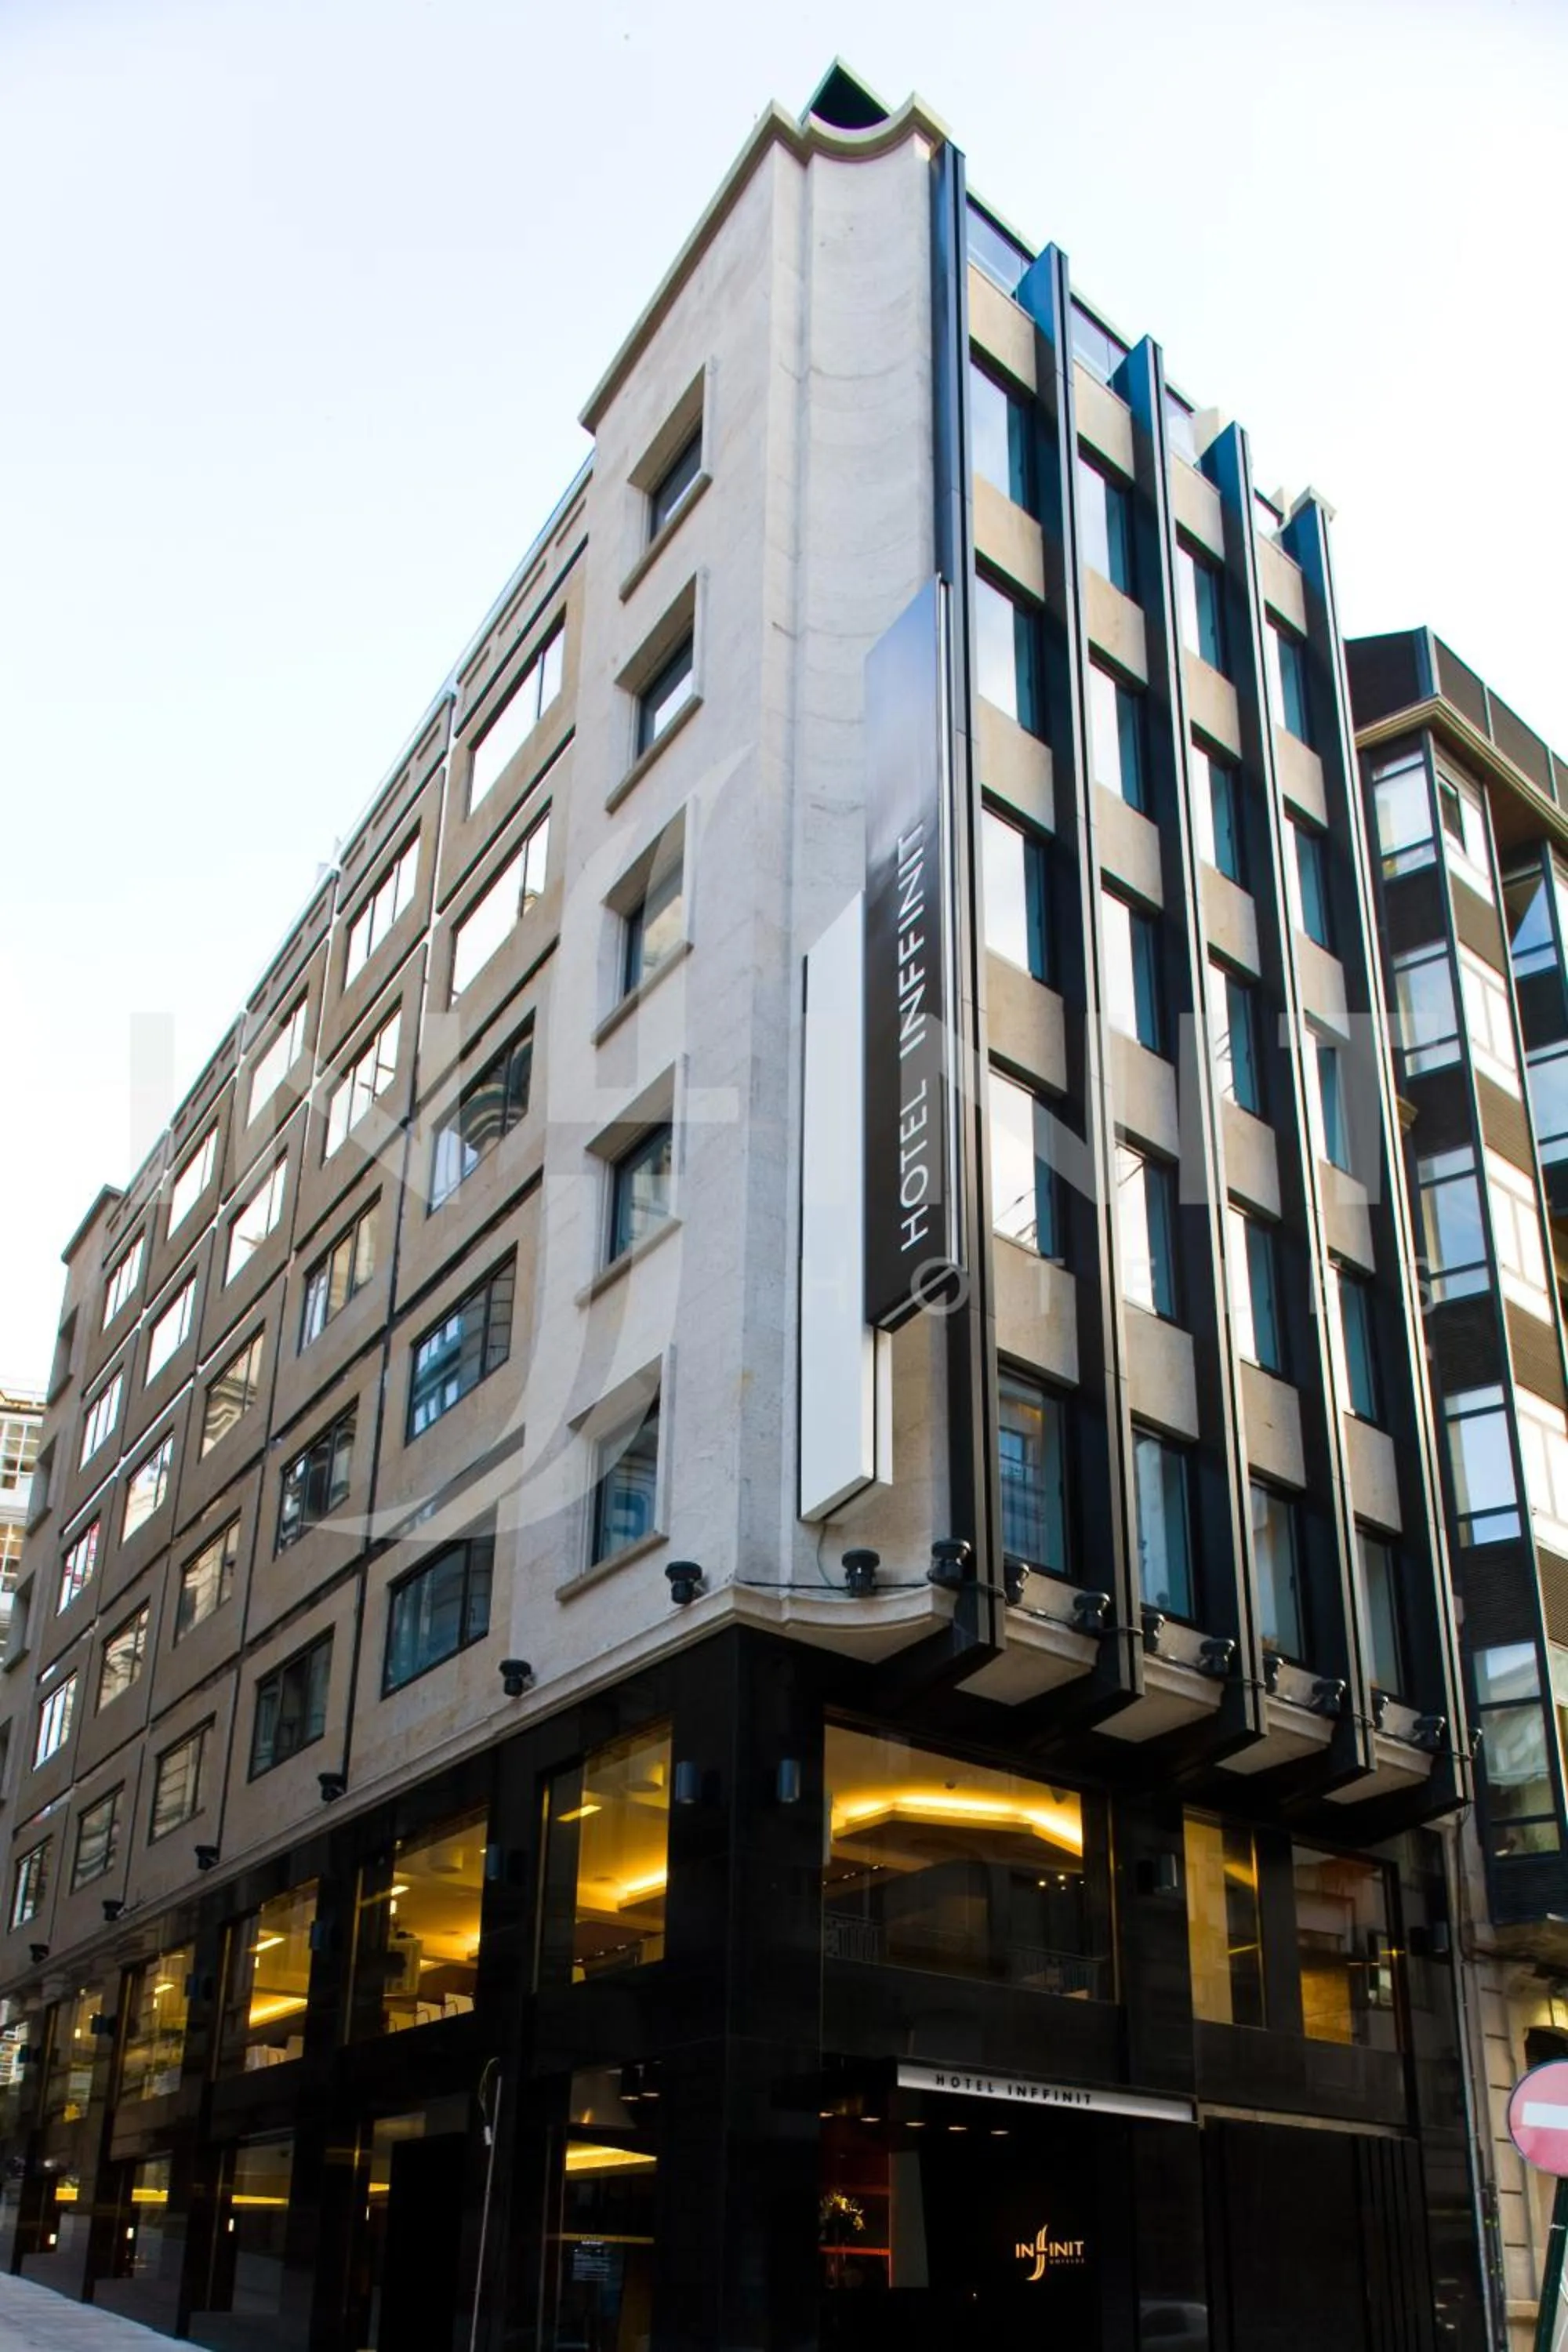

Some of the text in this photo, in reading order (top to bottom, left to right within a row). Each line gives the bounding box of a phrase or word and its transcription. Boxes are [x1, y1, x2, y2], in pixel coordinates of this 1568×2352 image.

[898, 824, 929, 1252] HOTEL INFFINIT
[935, 2073, 1092, 2105] HOTEL INFFINIT
